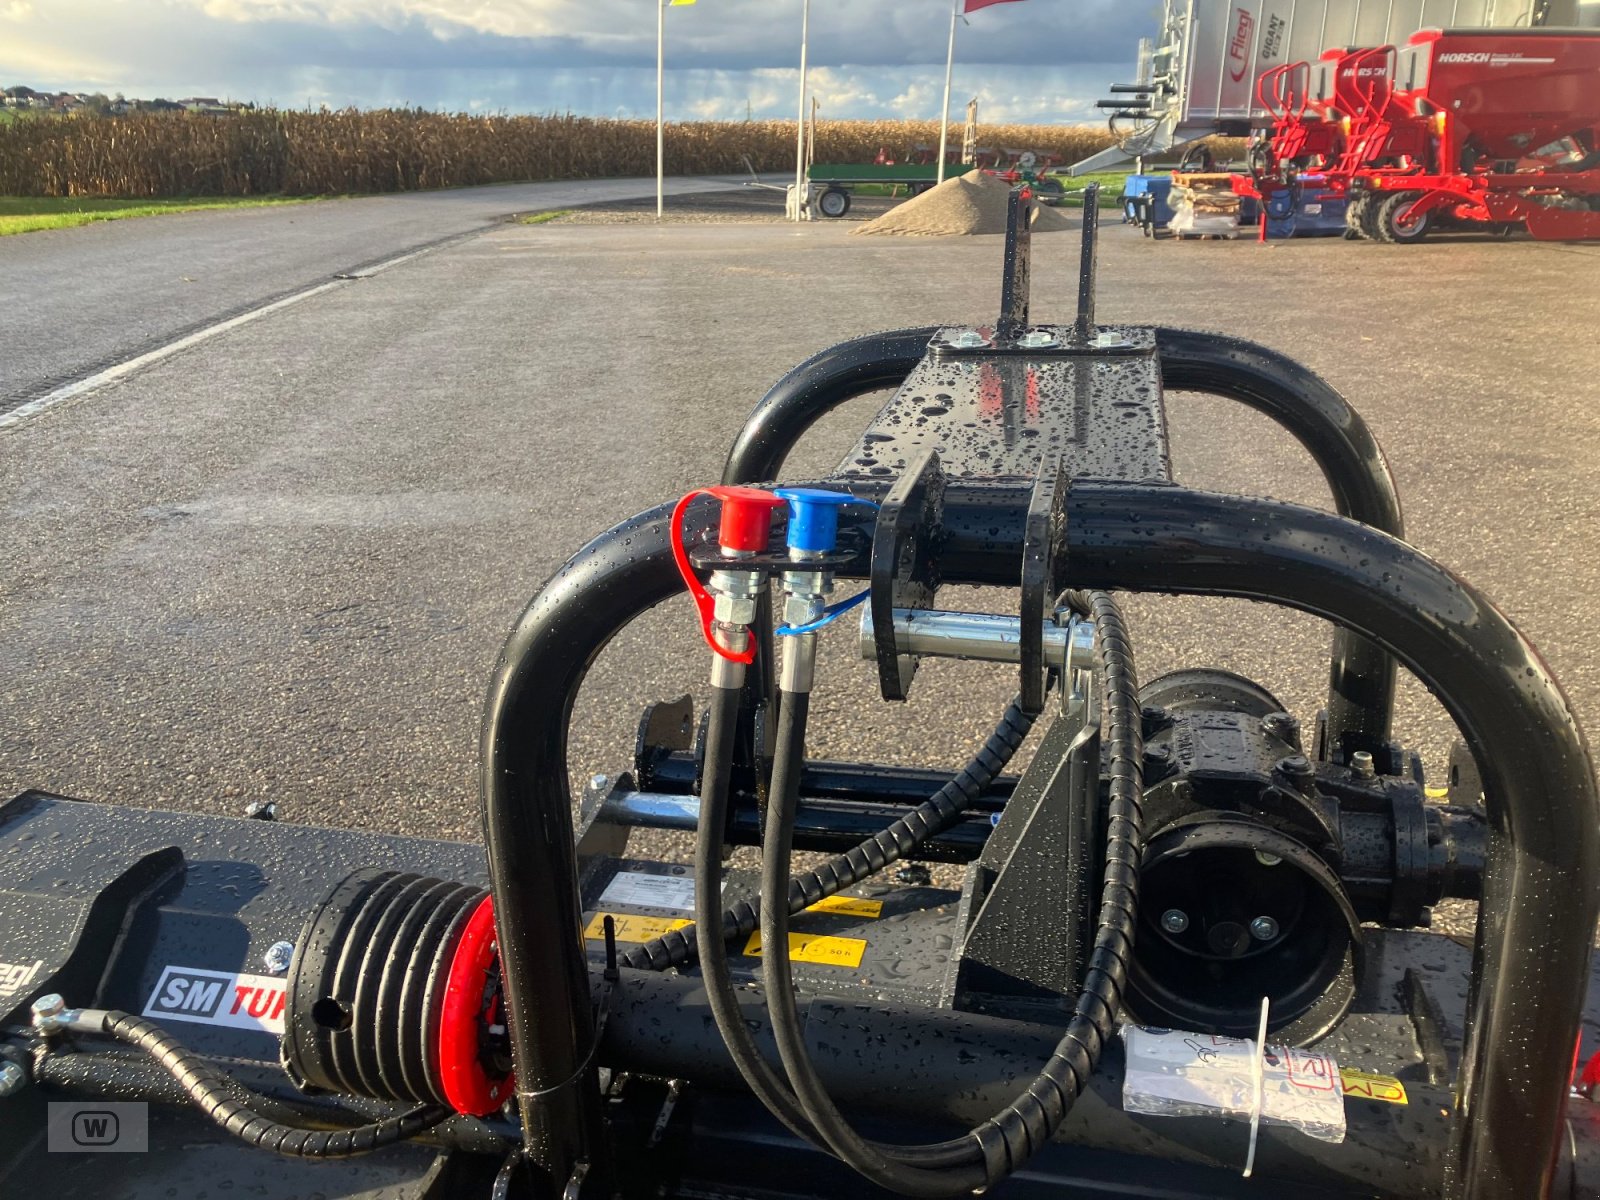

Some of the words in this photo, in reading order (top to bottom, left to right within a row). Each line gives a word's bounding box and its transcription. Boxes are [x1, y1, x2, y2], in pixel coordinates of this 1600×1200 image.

[1230, 7, 1253, 60] Fliegl
[1262, 12, 1279, 59] GIGANT
[1343, 67, 1386, 77] HRSCH
[1438, 52, 1491, 63] HORSCH
[159, 977, 223, 1012] SM
